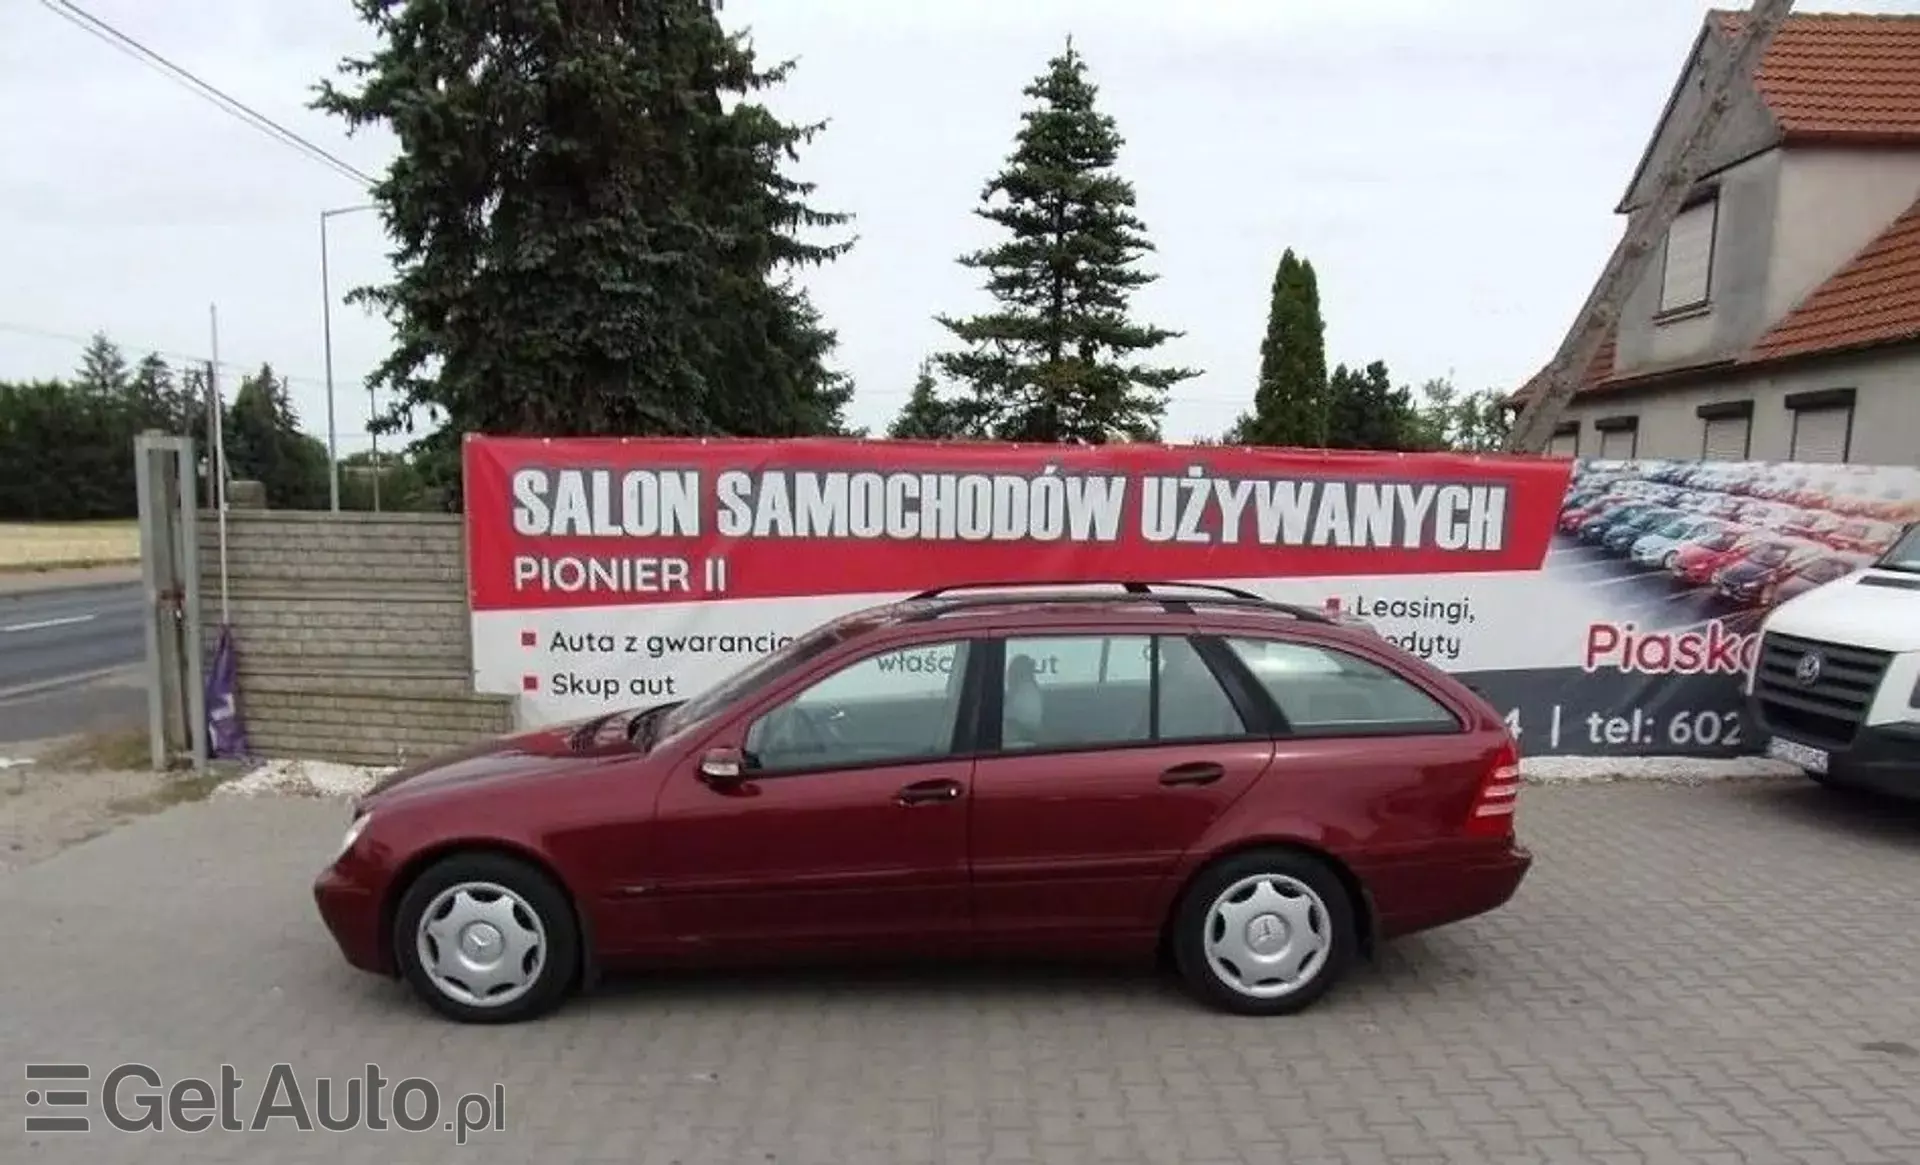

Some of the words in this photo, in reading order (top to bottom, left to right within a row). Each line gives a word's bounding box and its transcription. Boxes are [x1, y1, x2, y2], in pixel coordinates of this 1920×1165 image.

[512, 469, 700, 537] SALON
[717, 465, 1126, 542] SAMOCHODÓW
[1141, 465, 1506, 550] UŻYWANYCH
[514, 556, 690, 592] PIONIER
[705, 558, 727, 592] II
[1357, 595, 1475, 624] Leasingi,
[550, 631, 615, 652] Auta
[624, 635, 638, 652] z
[551, 673, 620, 699] Skup
[629, 675, 676, 696] aut
[1586, 708, 1655, 744] tel:
[1668, 710, 1741, 746] 602
